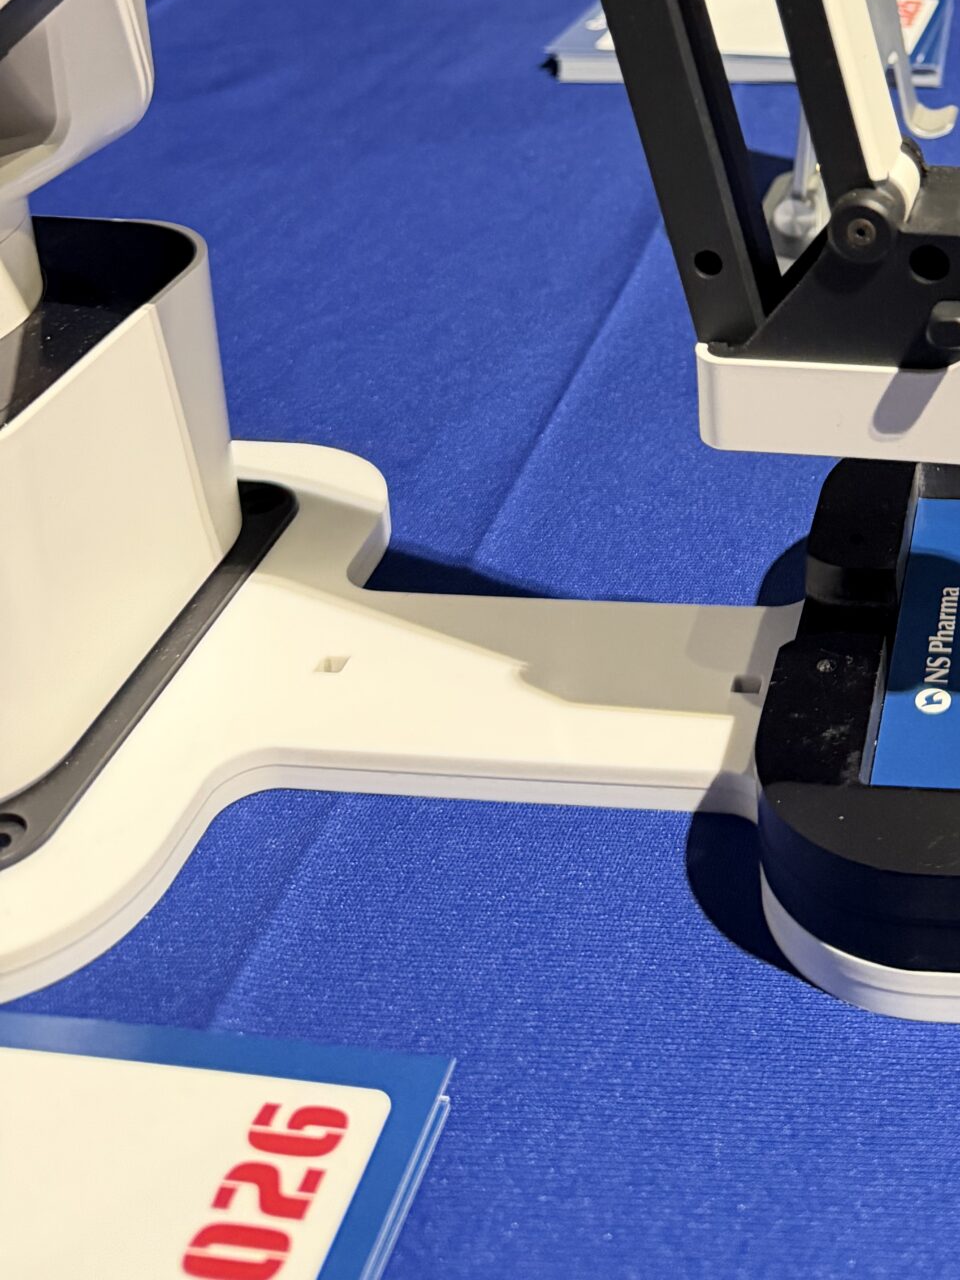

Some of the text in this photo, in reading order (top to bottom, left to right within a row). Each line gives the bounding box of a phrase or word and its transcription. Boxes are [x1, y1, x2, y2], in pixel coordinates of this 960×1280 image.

[924, 586, 960, 683] NS Pharma
[181, 1101, 350, 1280] 026
